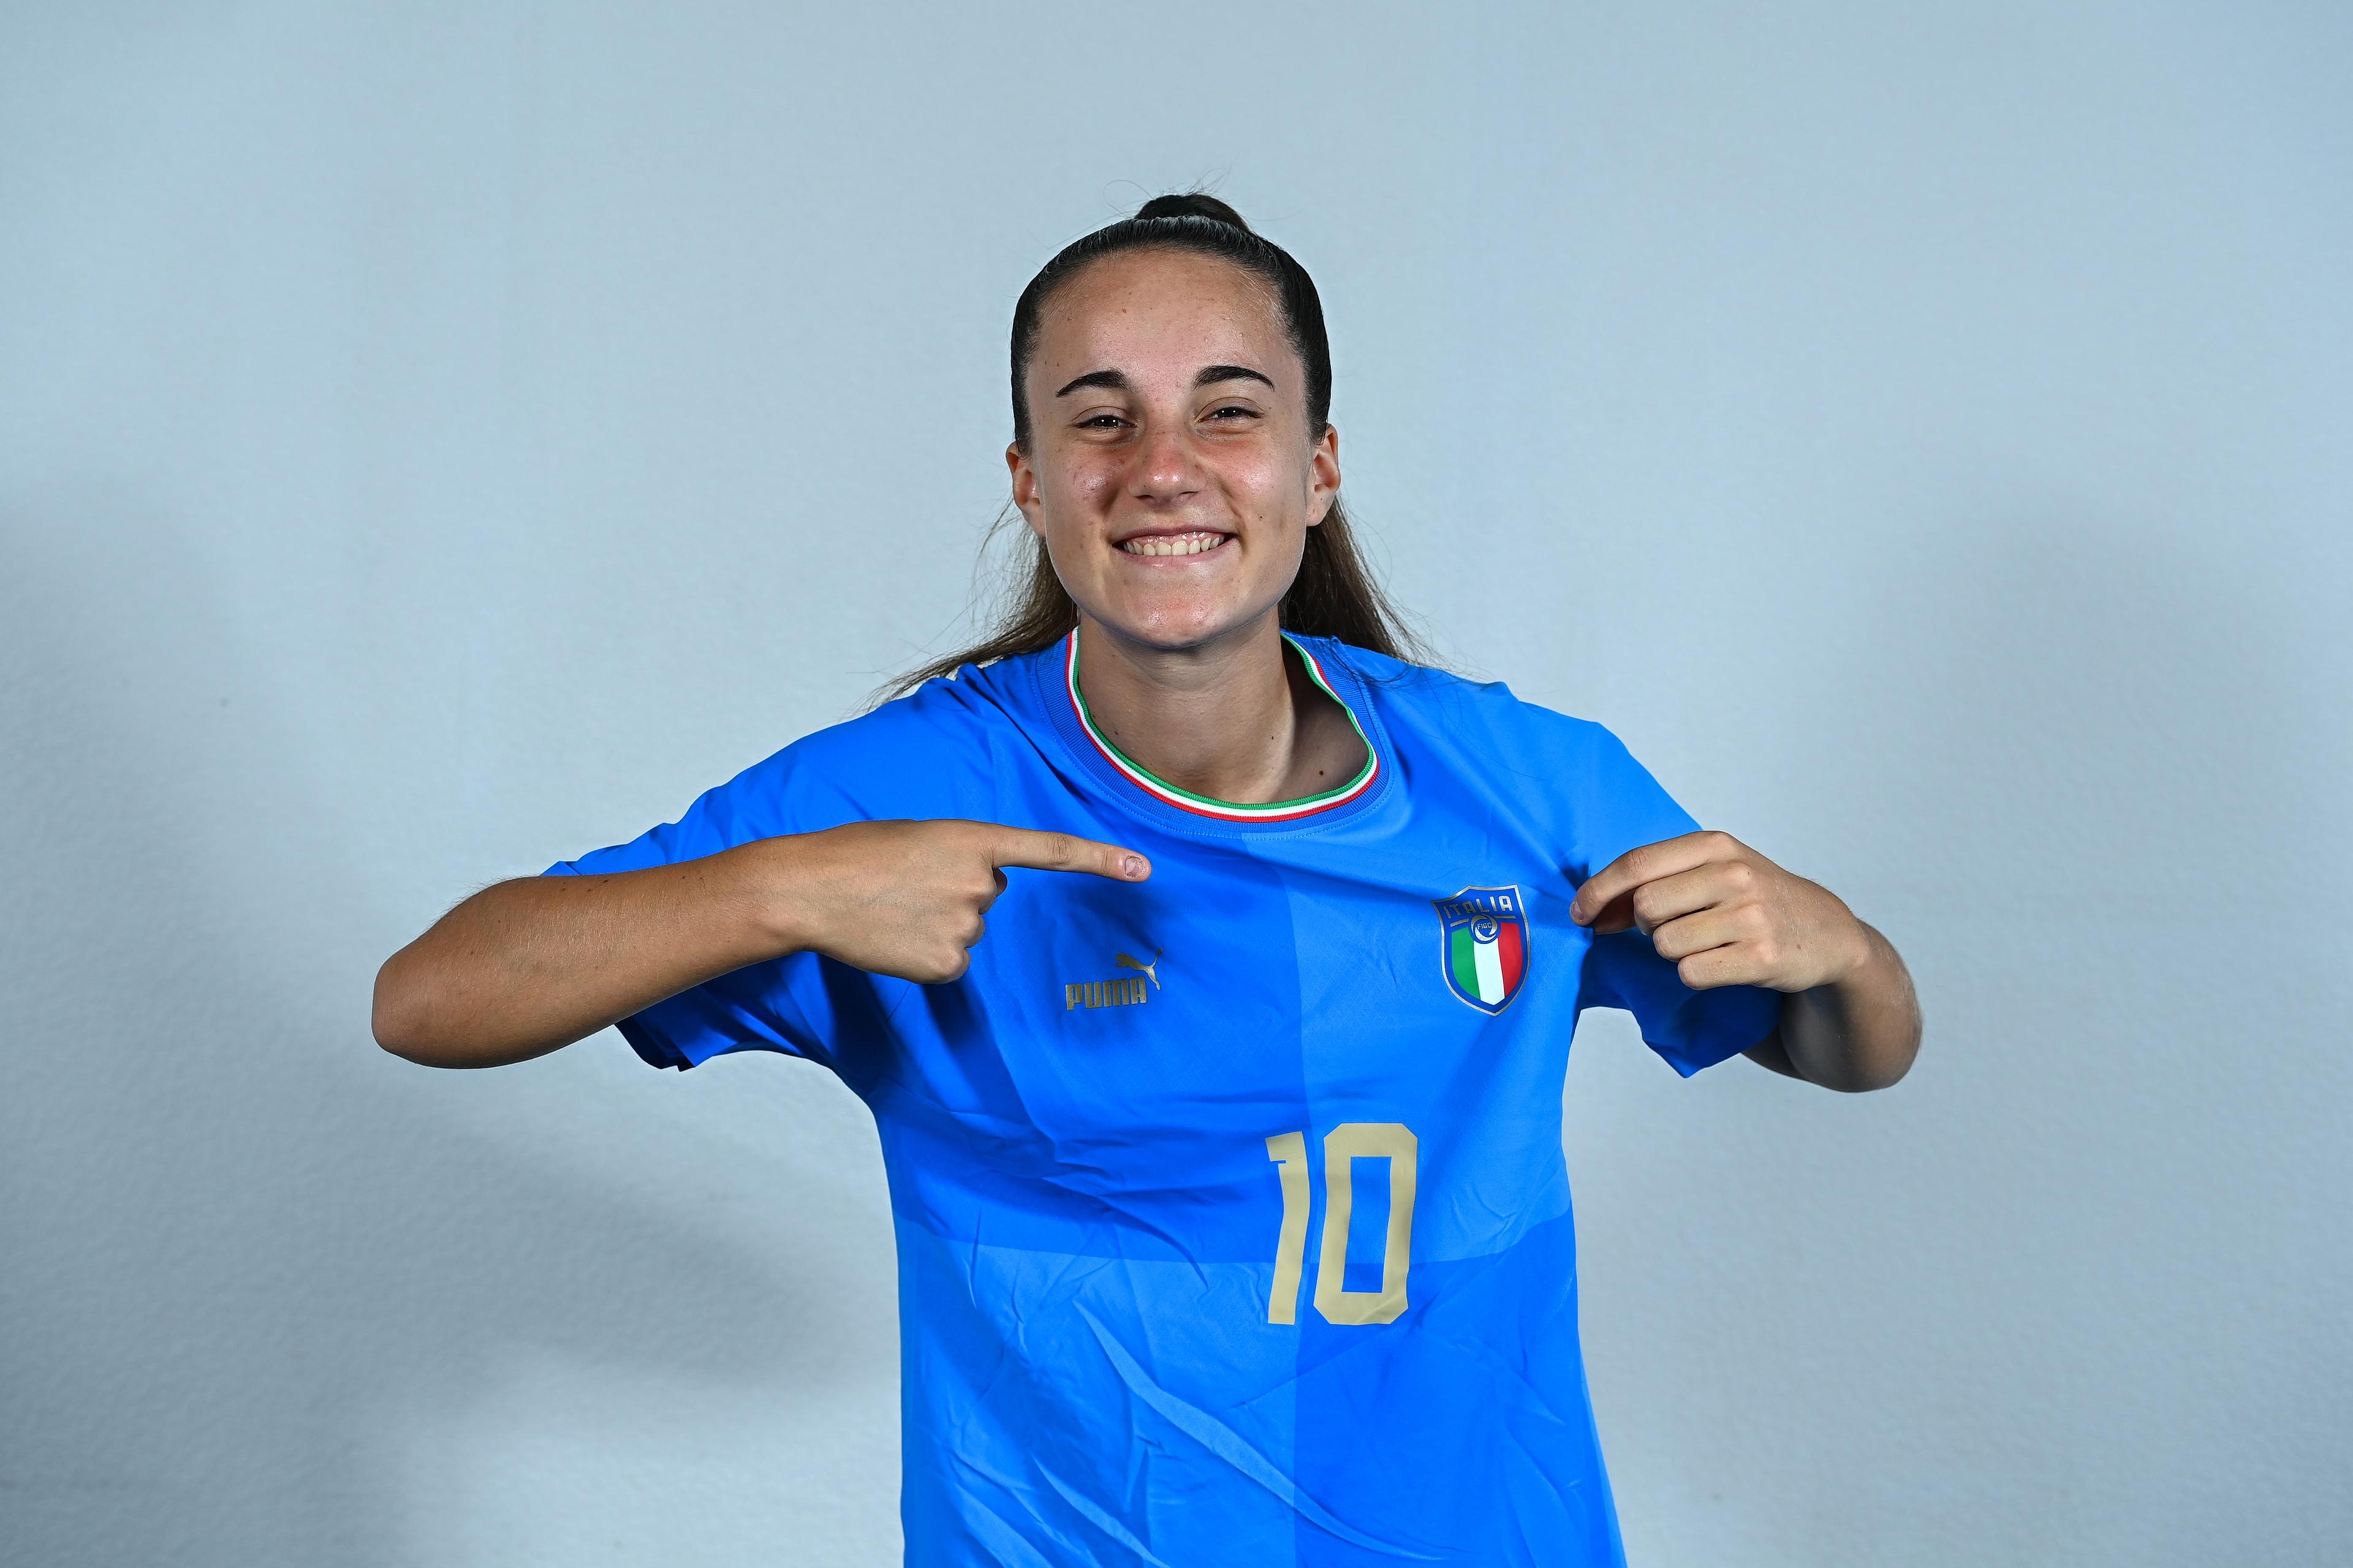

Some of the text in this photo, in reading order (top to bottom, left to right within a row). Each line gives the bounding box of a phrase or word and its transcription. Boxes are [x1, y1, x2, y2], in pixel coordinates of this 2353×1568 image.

[1443, 895, 1513, 918] ITALIA
[1066, 977, 1147, 1010] PUMA
[1265, 1123, 1418, 1325] 10
